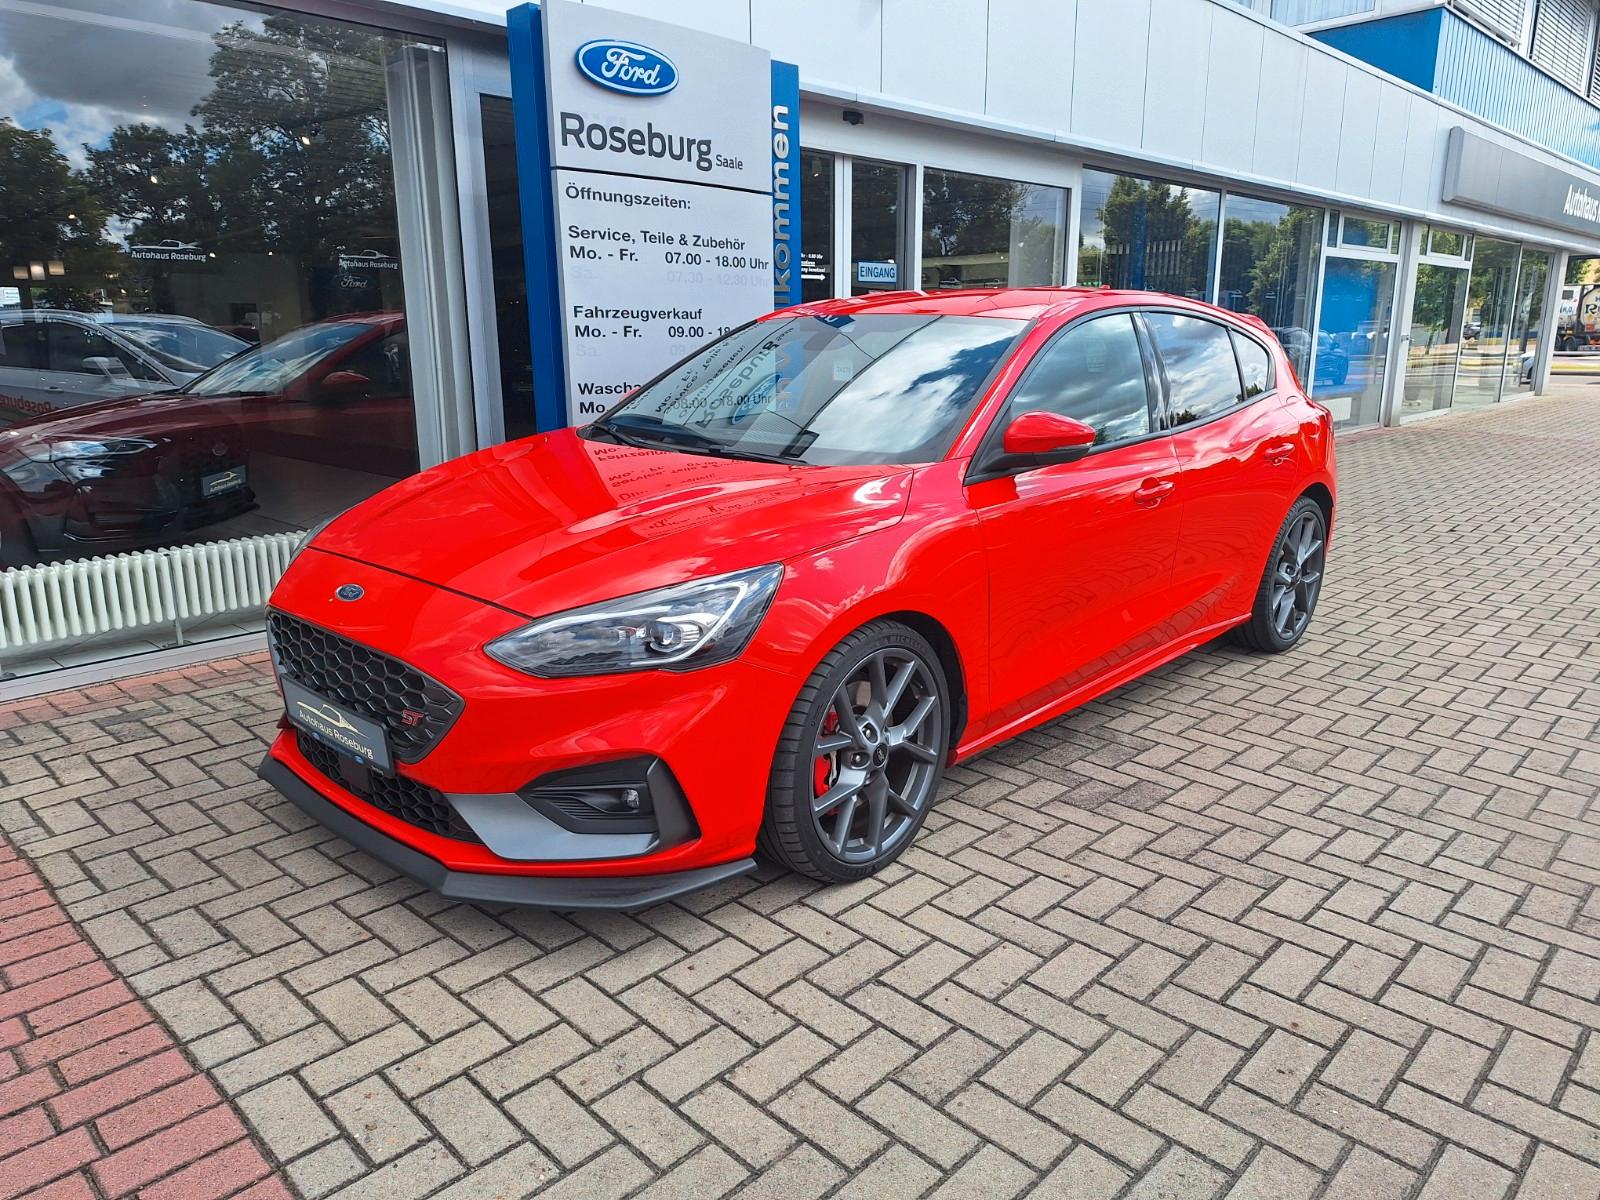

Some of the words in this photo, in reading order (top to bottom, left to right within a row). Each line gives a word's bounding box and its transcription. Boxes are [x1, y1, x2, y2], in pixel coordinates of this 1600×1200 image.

[601, 47, 661, 87] Ford
[560, 111, 712, 172] Roseburg
[715, 154, 743, 171] Saale
[565, 182, 692, 210] Öffnungszeiten:
[568, 225, 636, 245] Service,
[640, 231, 675, 245] Teile
[678, 233, 689, 246] &
[692, 235, 746, 251] Zubehör
[131, 251, 170, 261] Autohaus
[171, 252, 207, 263] Roseburg
[569, 245, 602, 260] Mo.
[619, 249, 639, 262] Fr.
[664, 251, 702, 266] 07.00
[715, 255, 746, 269] 18.00
[749, 257, 769, 270] Uhr
[340, 275, 368, 288] Ford
[859, 265, 896, 279] EINGANG
[573, 306, 703, 322] Fahrzeugverkauf
[574, 325, 607, 338] Mo.
[623, 326, 643, 338] Fr.
[668, 326, 704, 338] 09.00
[401, 709, 424, 725] ST
[299, 709, 334, 738] Autohaus
[333, 729, 374, 760] Roseburg
